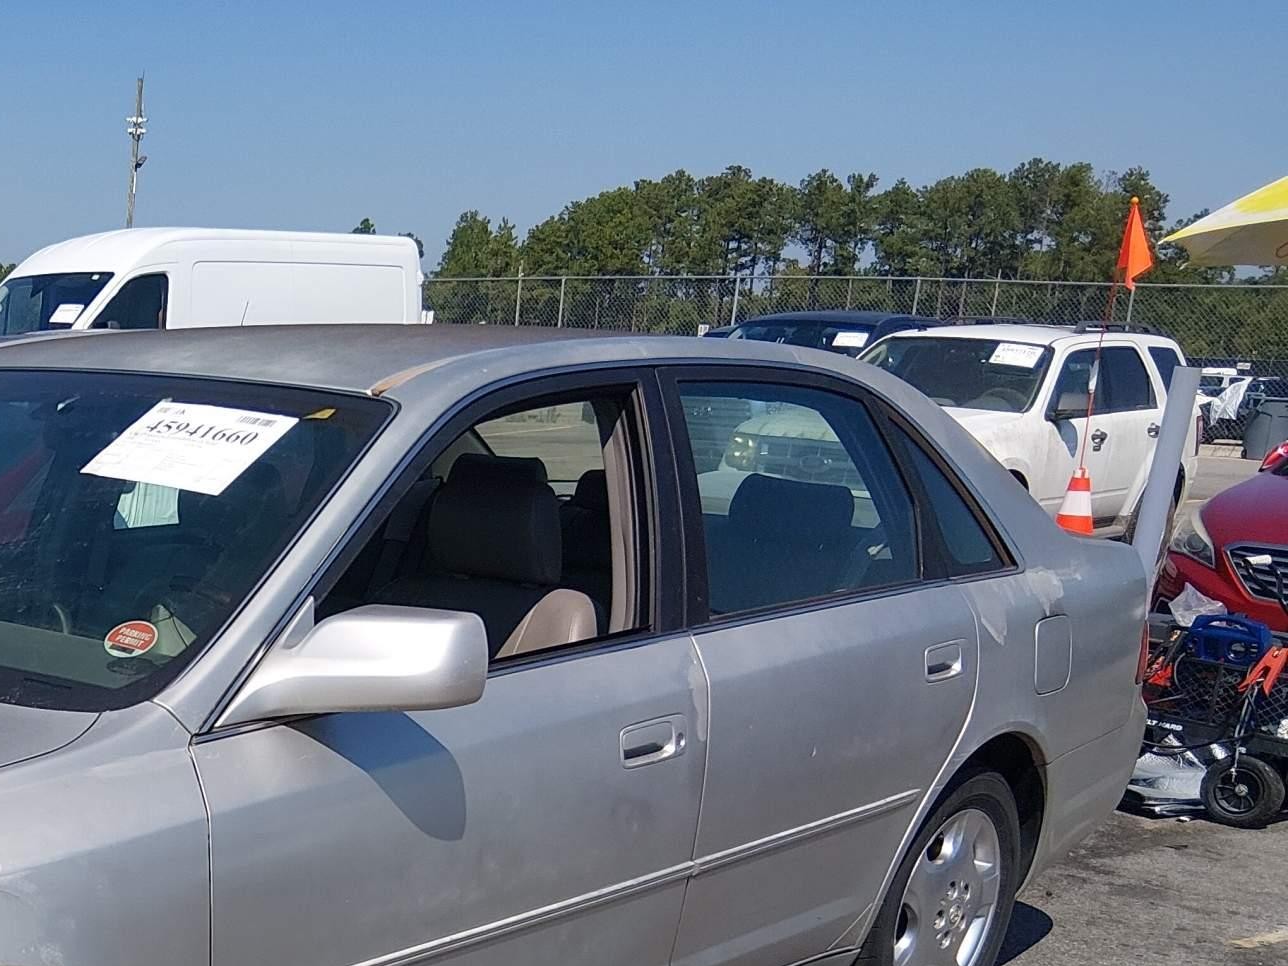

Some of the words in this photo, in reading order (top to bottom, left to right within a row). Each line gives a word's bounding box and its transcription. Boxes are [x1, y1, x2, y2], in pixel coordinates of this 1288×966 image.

[146, 419, 259, 446] 45941660
[114, 634, 145, 648] PERMIT
[118, 627, 153, 641] PARKING
